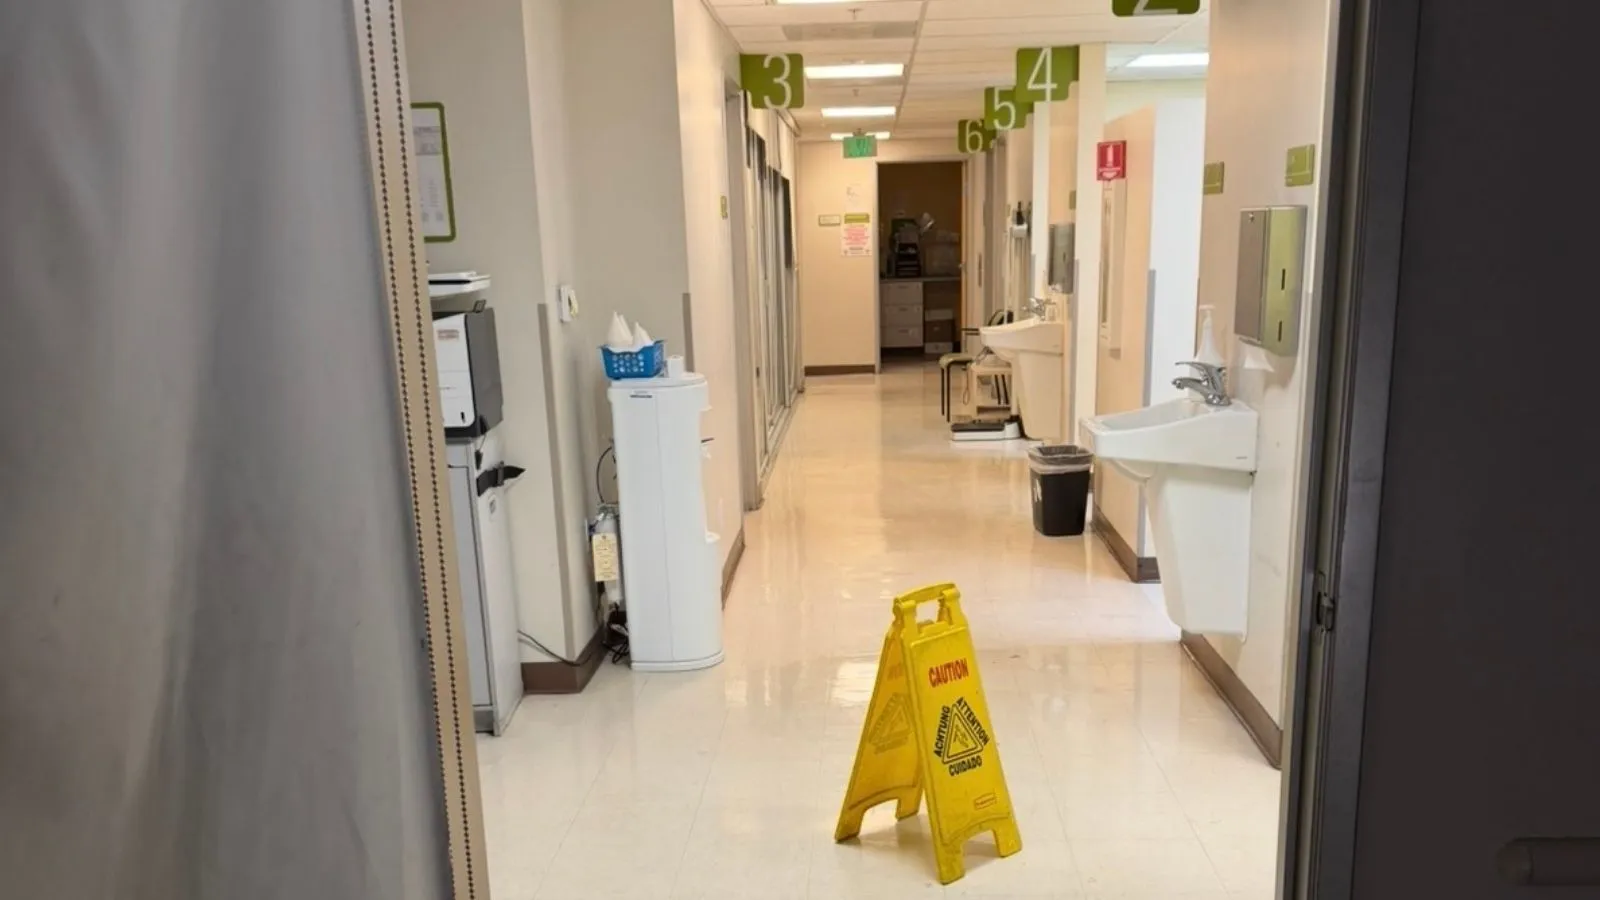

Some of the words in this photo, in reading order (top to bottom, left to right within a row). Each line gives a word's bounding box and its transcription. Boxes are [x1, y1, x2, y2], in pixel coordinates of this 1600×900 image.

[764, 54, 792, 110] 3
[1027, 47, 1057, 102] 4
[993, 87, 1016, 130] 5
[965, 120, 983, 153] 6
[929, 659, 968, 687] CAUTION
[934, 705, 951, 757] ACHTUNG
[956, 697, 989, 746] ATTENTION
[949, 756, 982, 776] CUIDADO
